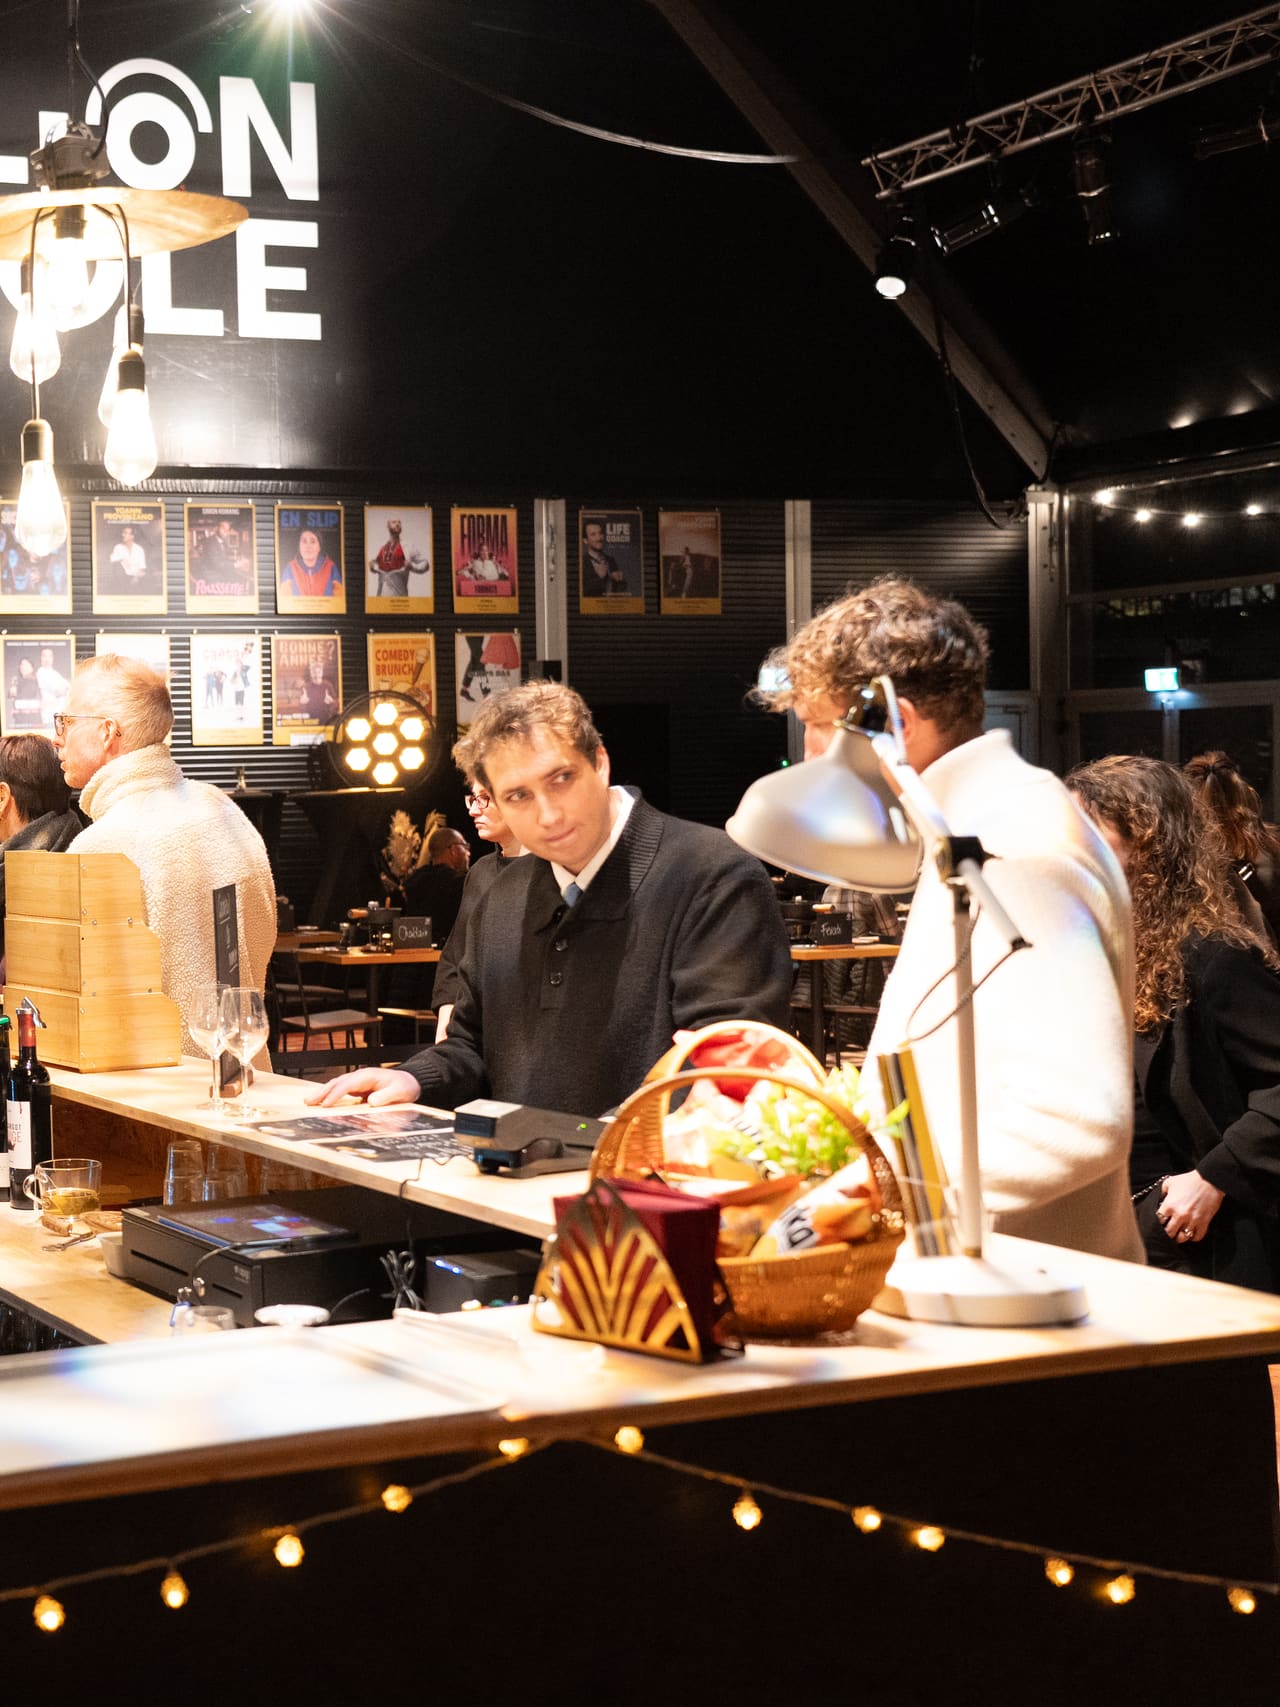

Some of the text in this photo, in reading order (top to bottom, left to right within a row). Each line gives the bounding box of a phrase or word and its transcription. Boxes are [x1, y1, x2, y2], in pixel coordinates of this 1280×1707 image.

[280, 510, 339, 529] EN SLIP
[460, 513, 509, 557] FORMA
[606, 522, 631, 536] LIFE
[279, 640, 325, 655] BONNE
[375, 649, 416, 662] COMEDY
[375, 663, 415, 676] BRUNCH
